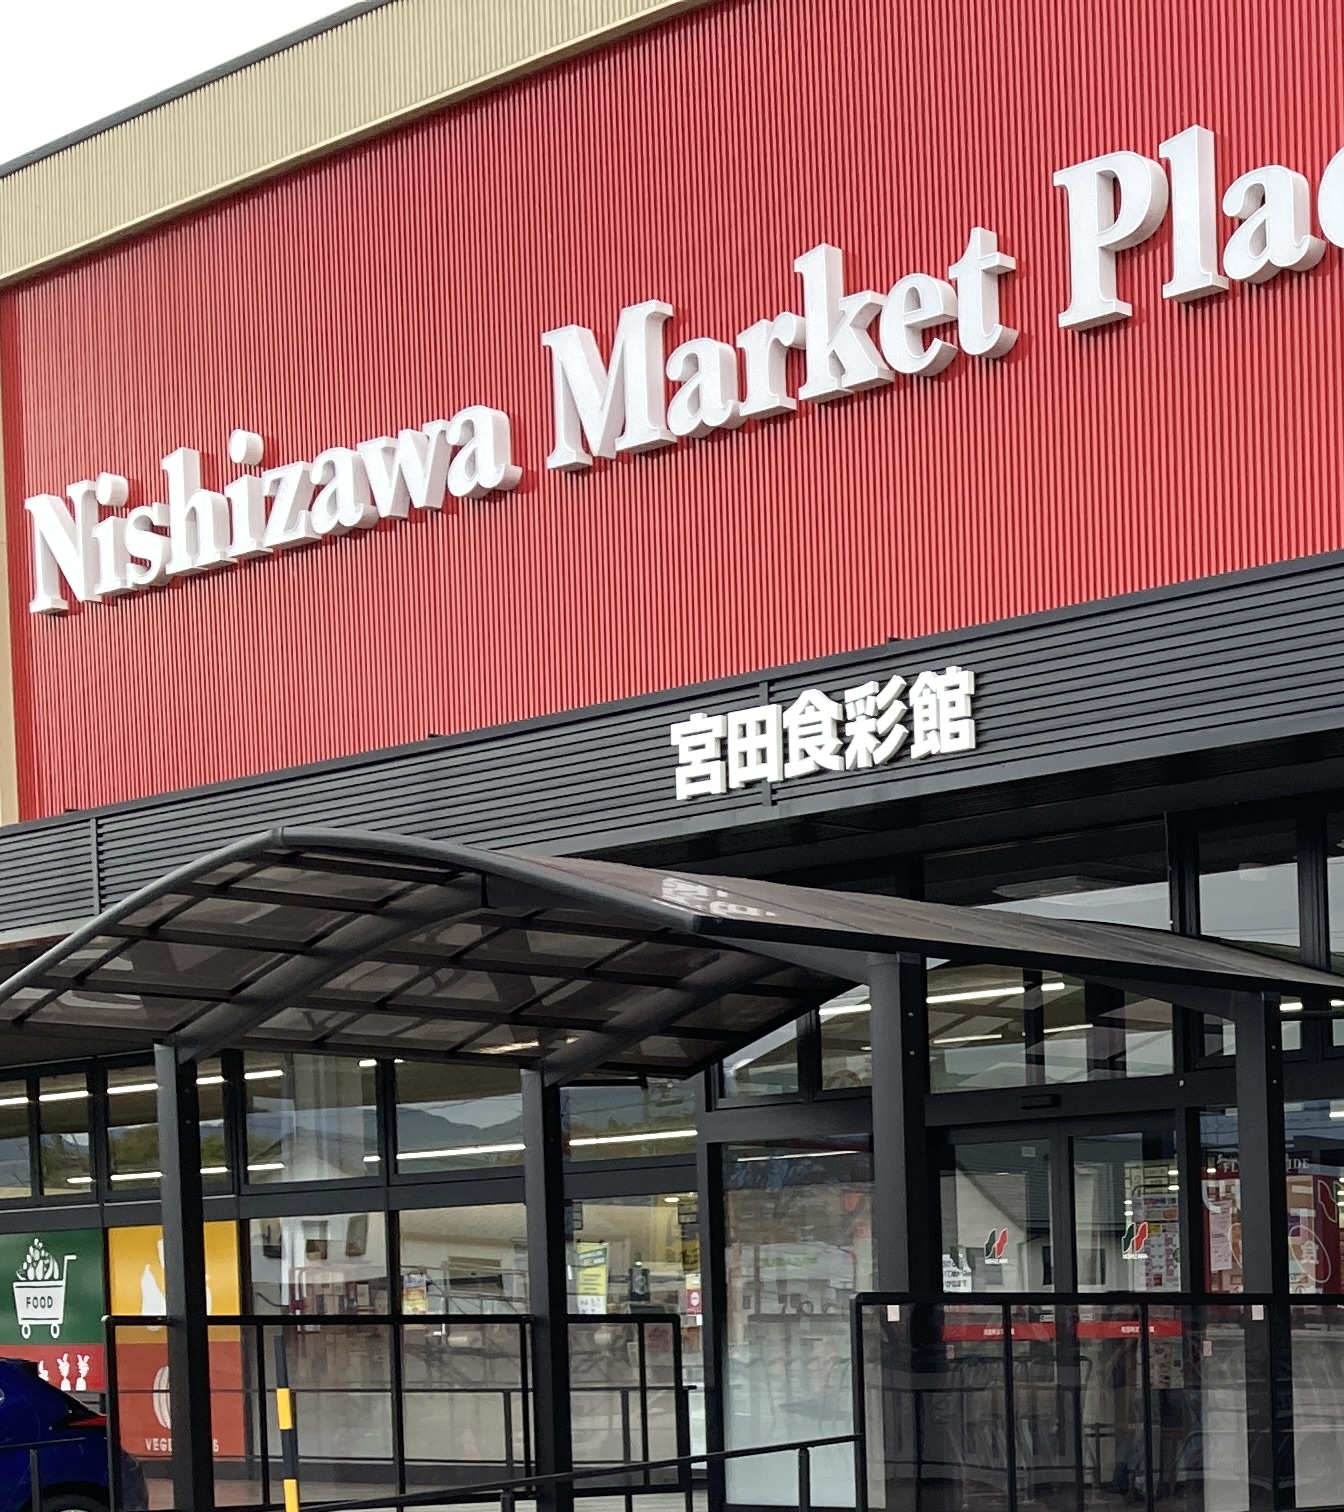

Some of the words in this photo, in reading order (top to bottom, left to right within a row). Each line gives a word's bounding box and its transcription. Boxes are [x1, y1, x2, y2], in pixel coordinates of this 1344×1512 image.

[24, 405, 523, 615] Nishizawa
[541, 226, 1019, 472] Market
[670, 666, 977, 800] 宮田食彩館
[25, 1296, 53, 1309] FOOD
